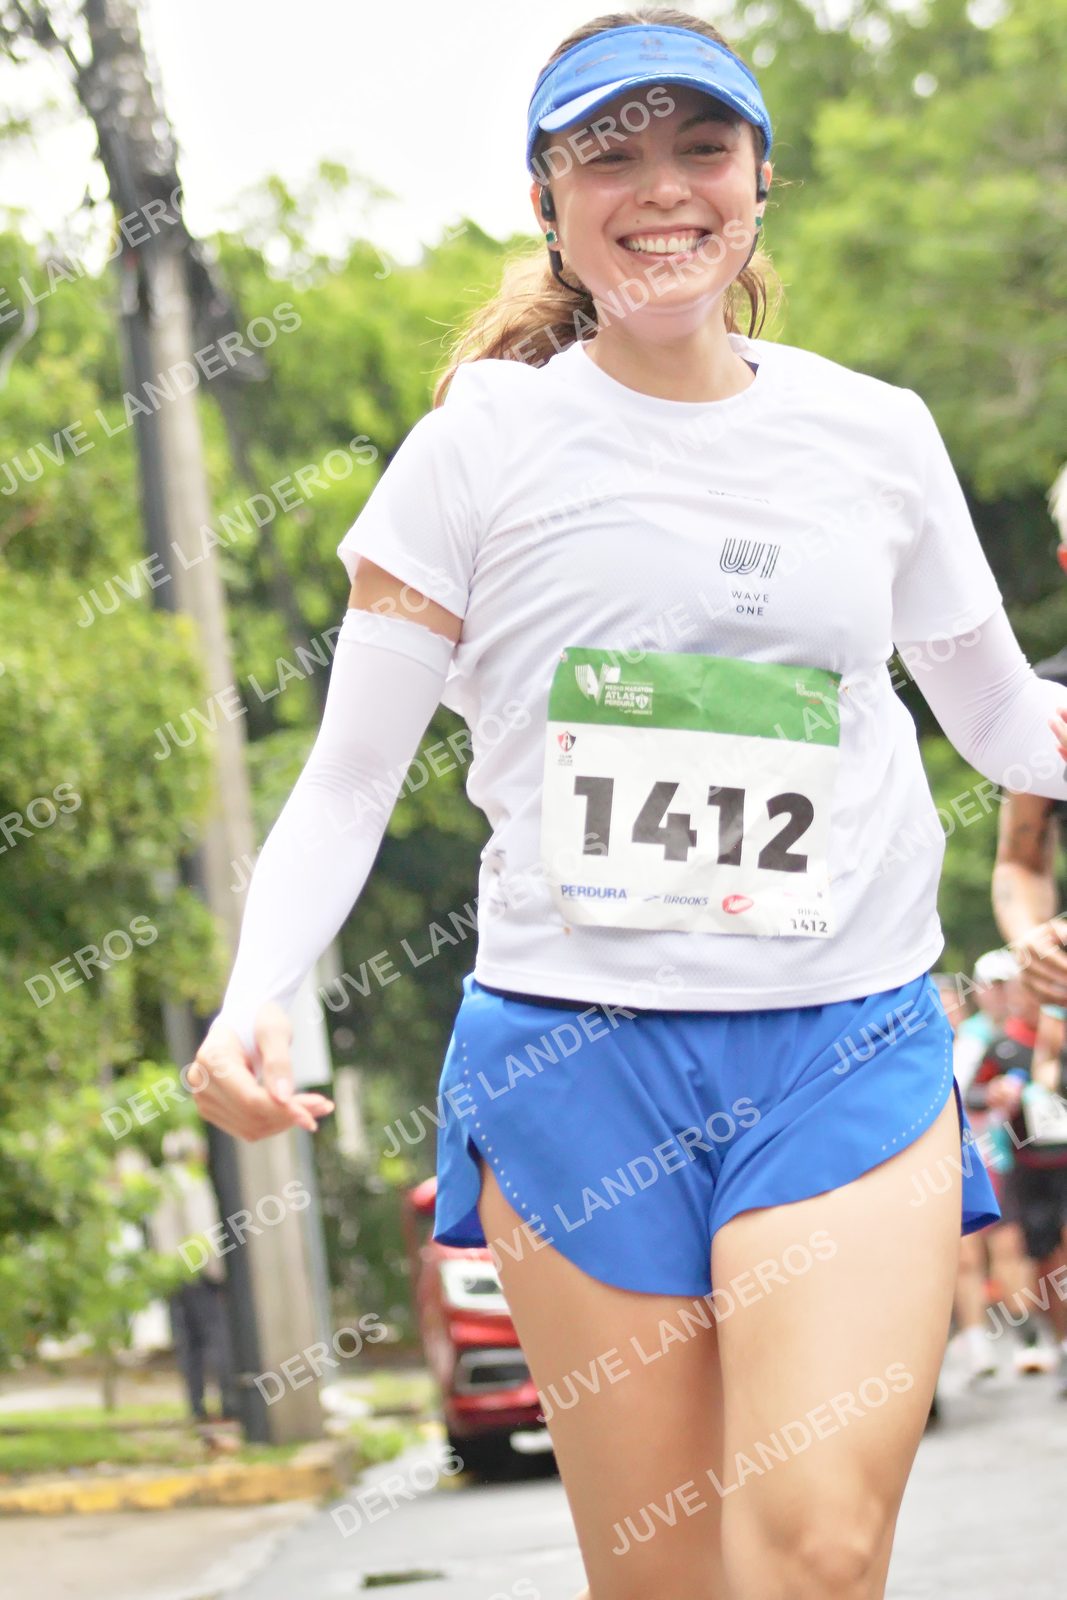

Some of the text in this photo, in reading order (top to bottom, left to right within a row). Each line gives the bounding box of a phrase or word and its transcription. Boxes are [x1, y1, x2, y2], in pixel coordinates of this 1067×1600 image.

[731, 590, 769, 603] WAVE
[736, 604, 764, 616] ONE
[605, 690, 635, 700] ATLAS
[573, 775, 815, 873] 1412
[560, 884, 709, 906] PERDURA BROOKS
[790, 918, 828, 934] 1412
